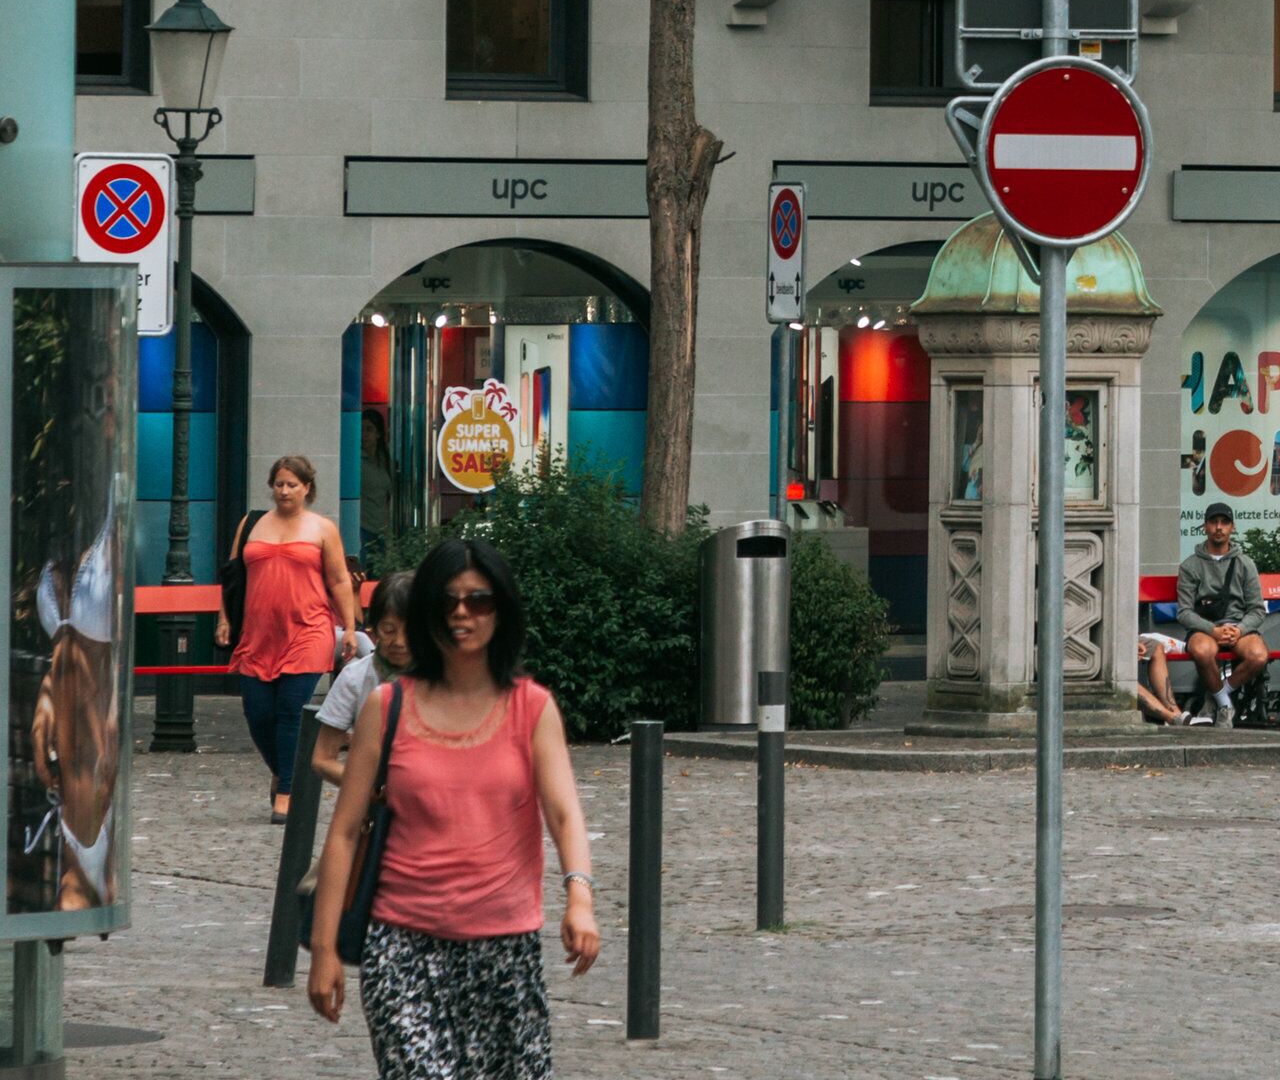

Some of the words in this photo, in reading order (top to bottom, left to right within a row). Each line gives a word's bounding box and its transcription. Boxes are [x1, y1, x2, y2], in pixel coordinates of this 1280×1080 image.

[492, 178, 548, 209] upc
[912, 182, 965, 212] upc
[422, 277, 451, 293] upc
[838, 278, 865, 294] upc
[456, 423, 501, 439] SUPER
[447, 439, 509, 452] SUMMER
[1234, 510, 1261, 520] letzte
